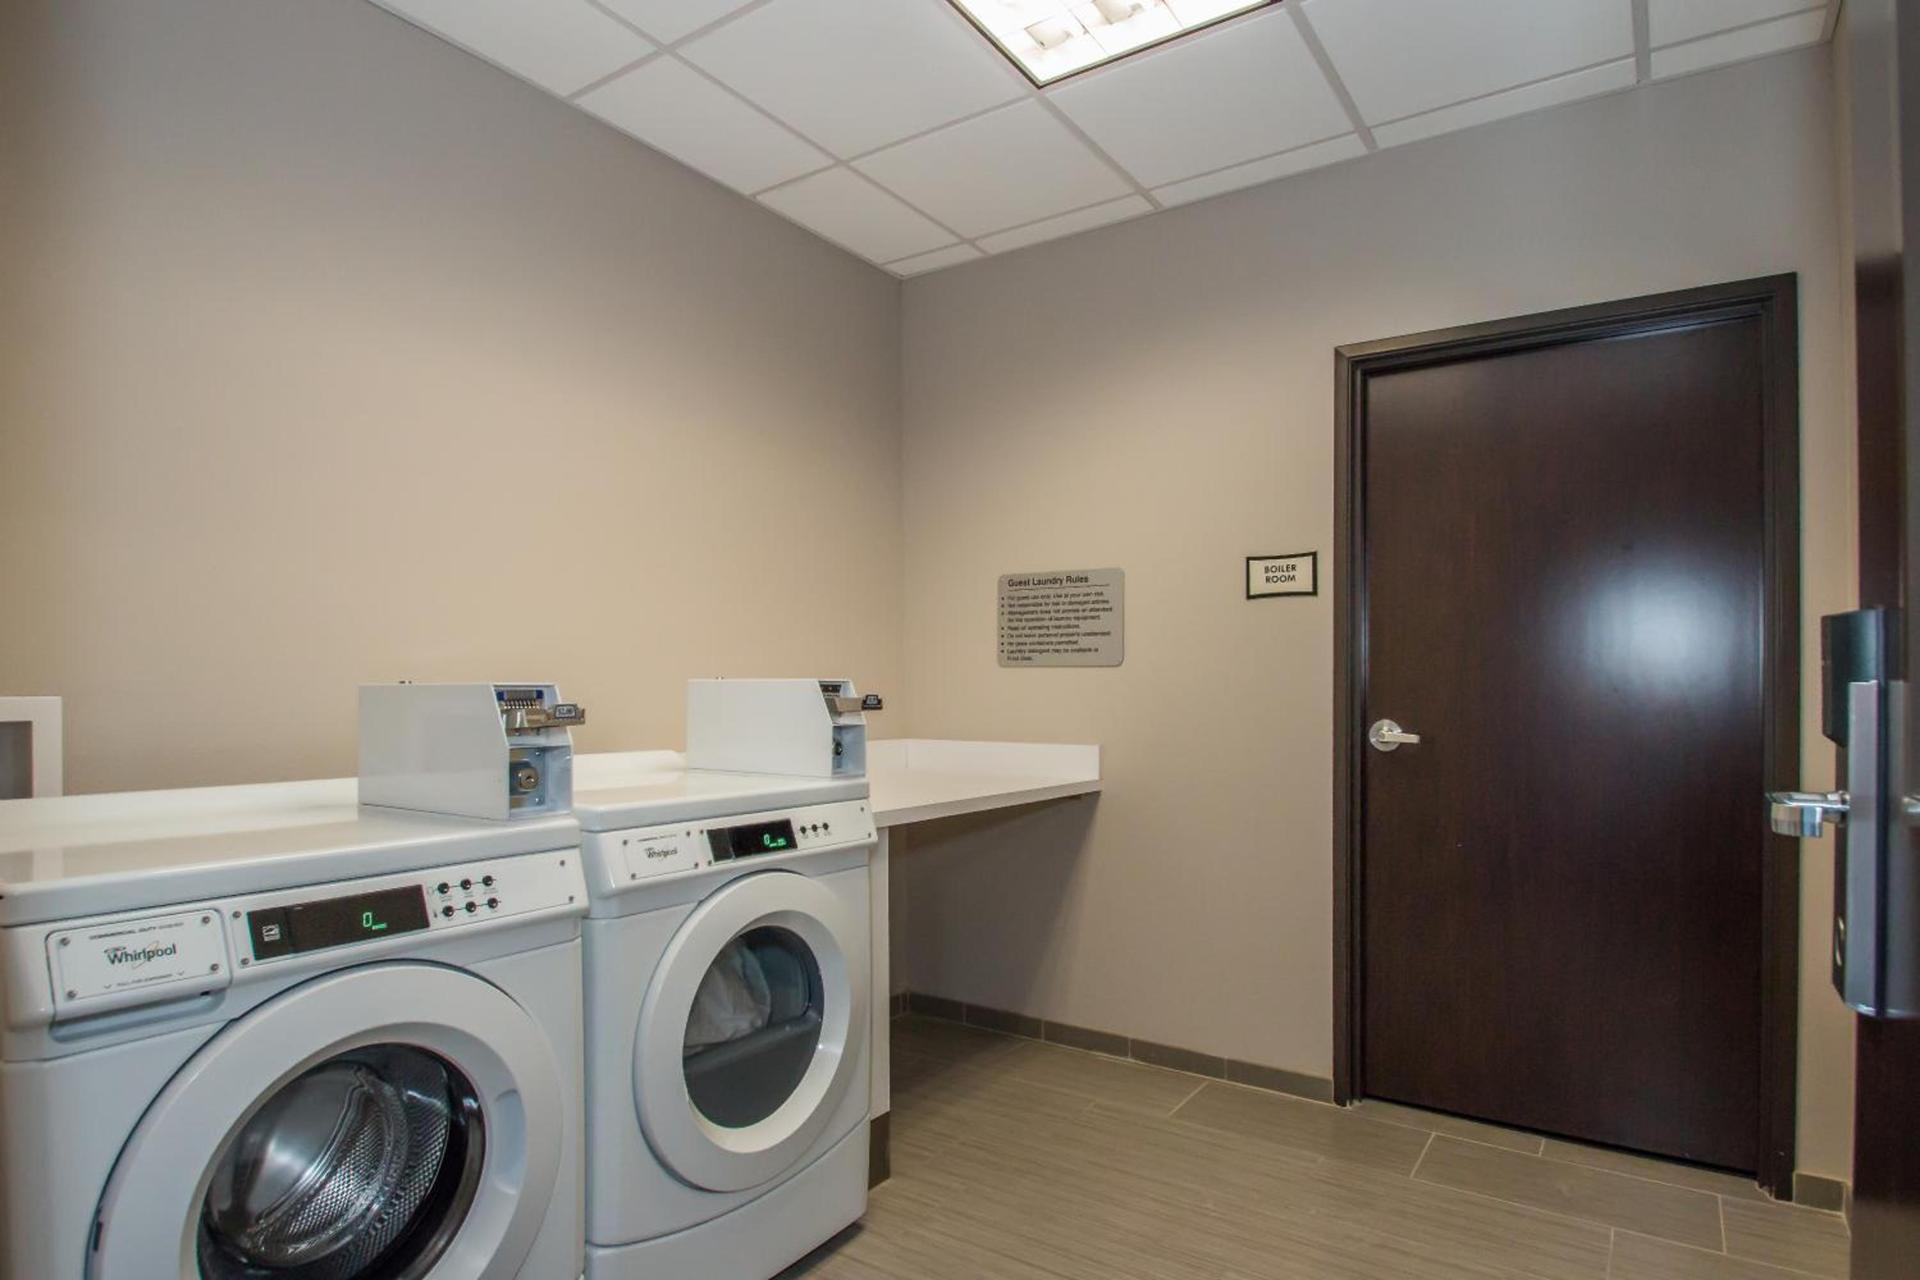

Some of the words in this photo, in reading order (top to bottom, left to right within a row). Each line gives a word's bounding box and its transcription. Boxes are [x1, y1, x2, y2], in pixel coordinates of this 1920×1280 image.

[1264, 564, 1297, 574] BOILER
[1007, 577, 1030, 587] Guest
[1032, 576, 1064, 586] Laundry
[1065, 575, 1089, 584] Rules
[1265, 574, 1296, 584] ROOM
[646, 846, 678, 859] Whirlpool
[363, 912, 372, 928] 0
[106, 943, 177, 965] Whirlpool
